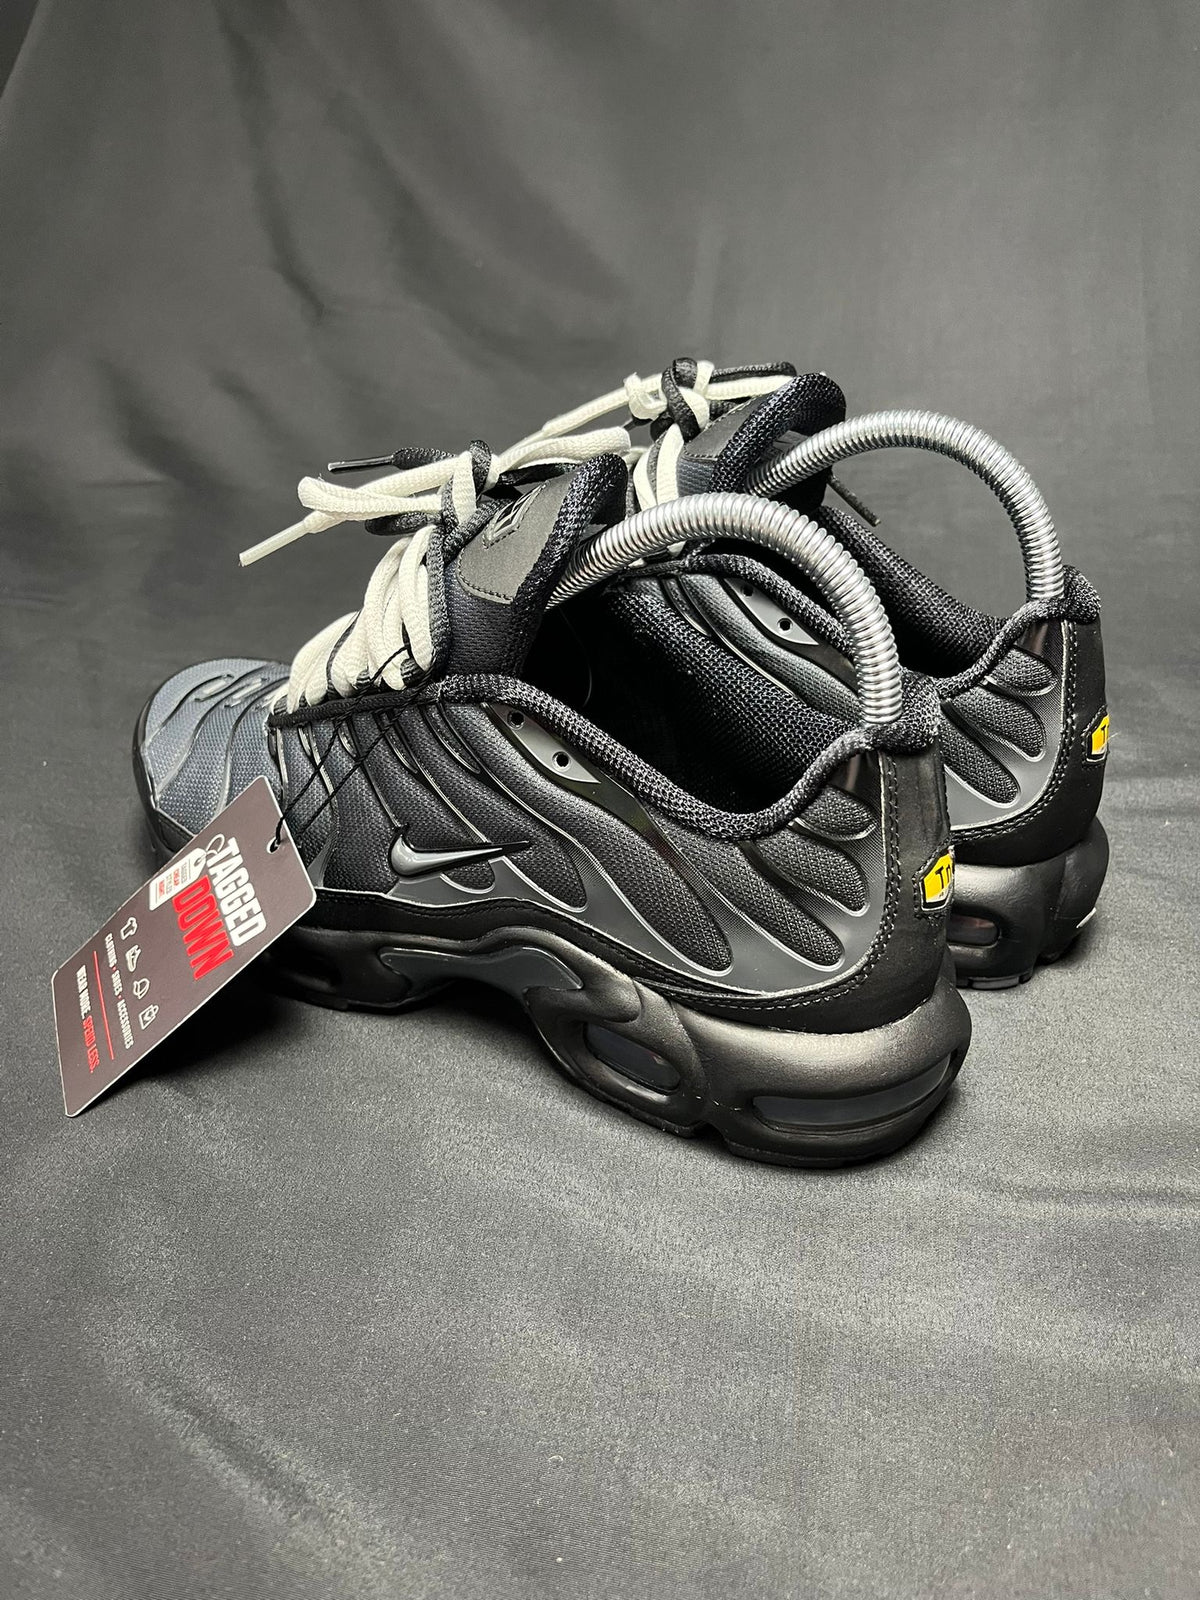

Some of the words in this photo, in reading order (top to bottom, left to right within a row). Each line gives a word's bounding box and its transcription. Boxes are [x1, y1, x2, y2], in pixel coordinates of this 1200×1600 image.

[206, 836, 267, 947] TAGGED
[171, 874, 235, 981] DOWN
[105, 932, 118, 968] CLOTHING
[76, 965, 88, 994] WEAR
[111, 969, 123, 996] SHOES
[79, 988, 91, 1020] MORE.
[83, 1015, 96, 1047] SPEND
[117, 999, 134, 1049] ACCESSORIES
[87, 1043, 100, 1073] LESS.
